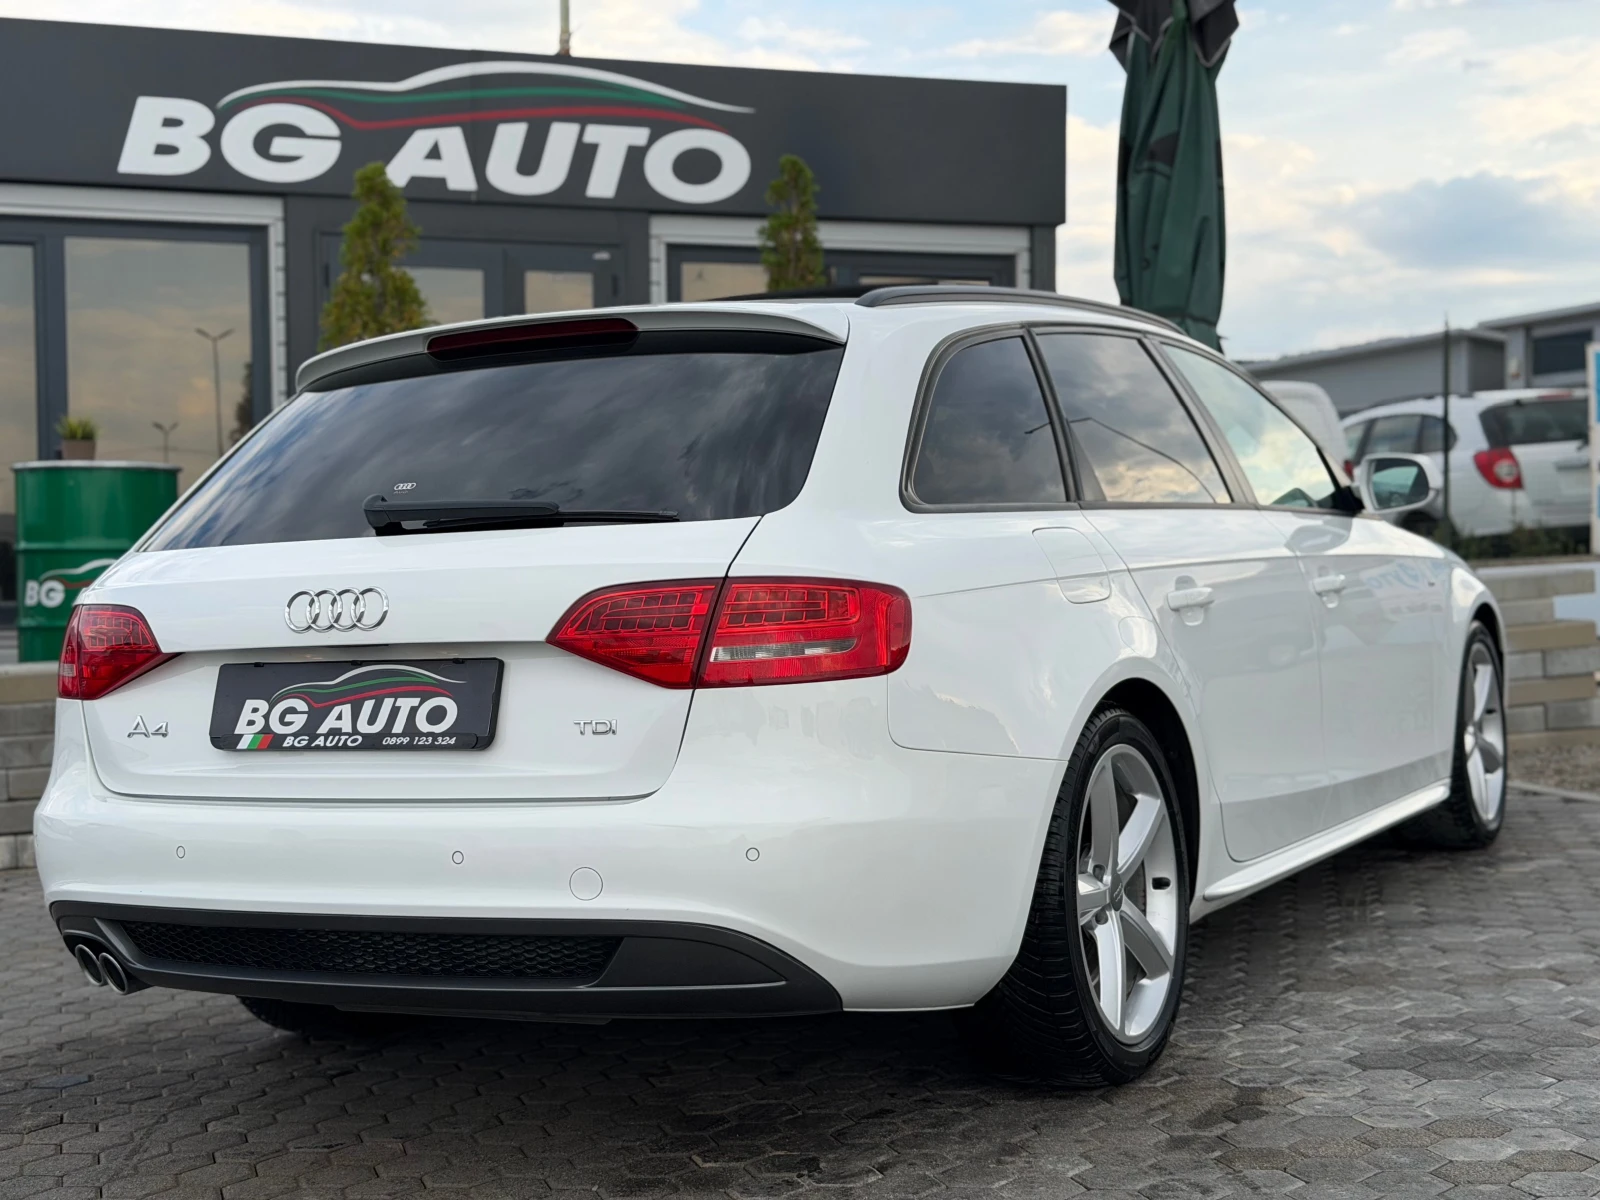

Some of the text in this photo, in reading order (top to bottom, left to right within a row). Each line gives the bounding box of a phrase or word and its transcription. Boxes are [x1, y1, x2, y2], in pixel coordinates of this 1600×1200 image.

[117, 95, 751, 204] BG AUTO
[24, 579, 66, 608] BG
[127, 714, 169, 738] A4
[234, 696, 458, 735] BG AUTO
[573, 719, 618, 736] TDI
[282, 735, 457, 748] BG AUTO 0899 123 324
